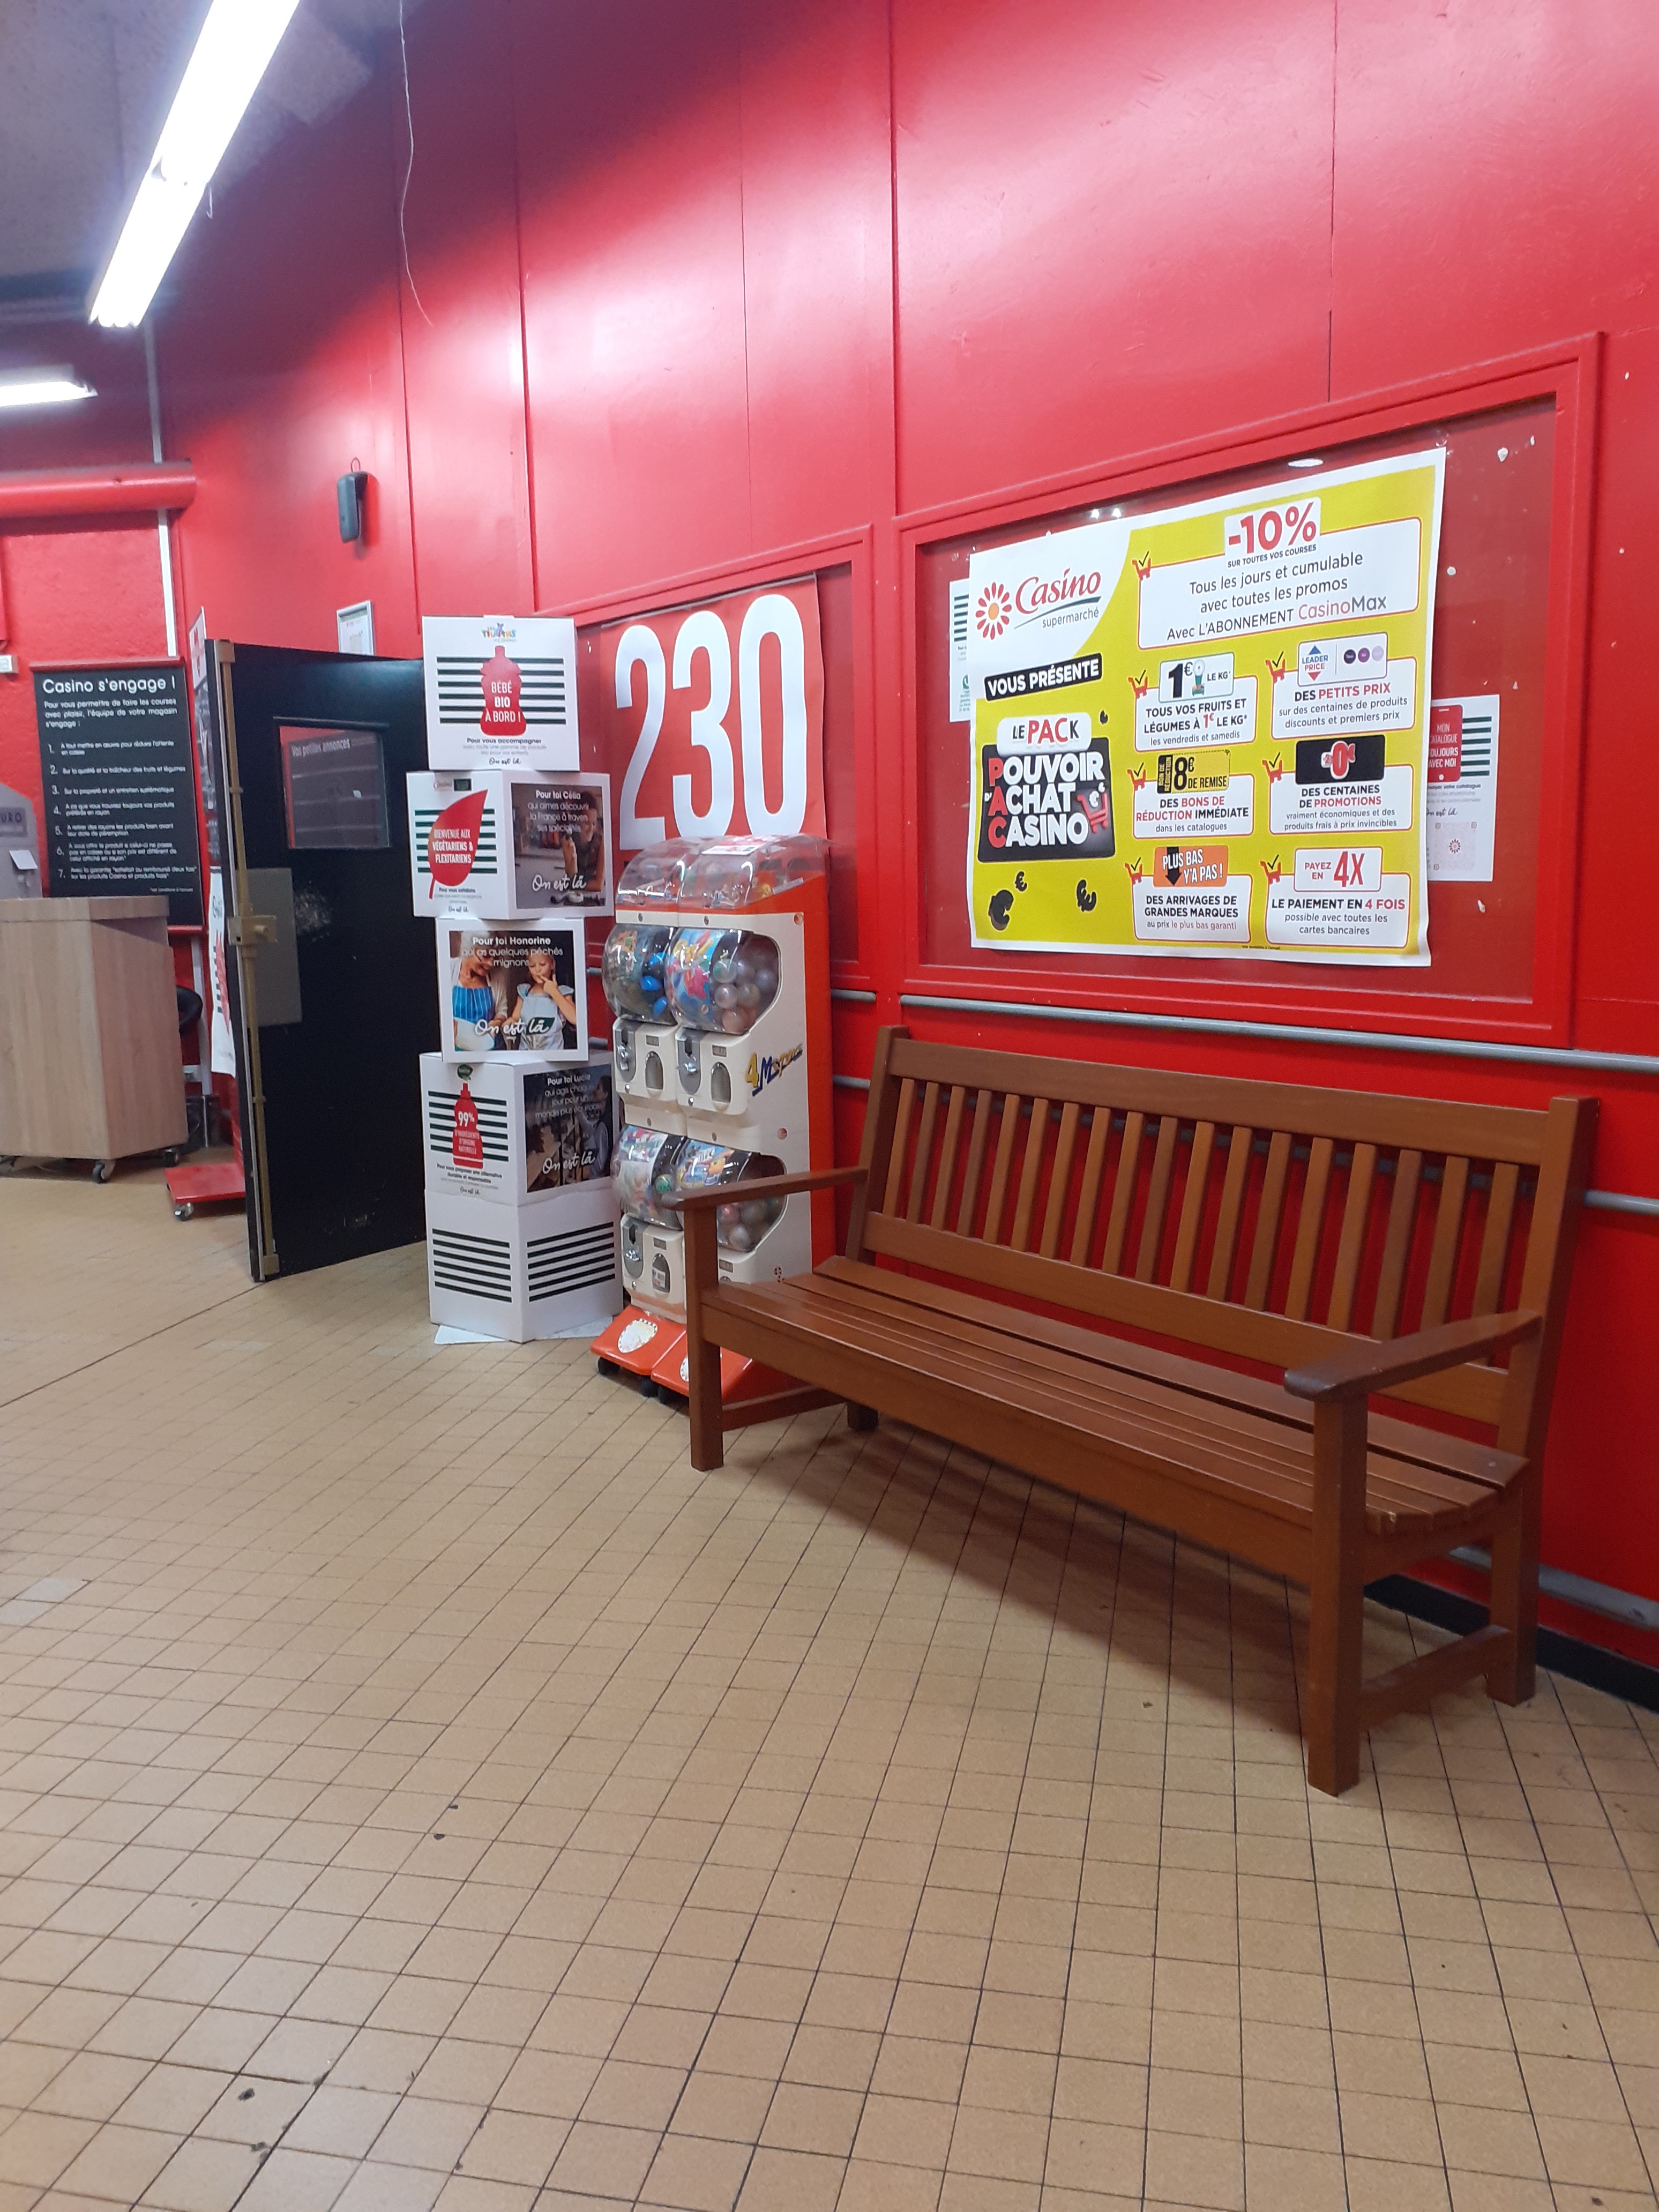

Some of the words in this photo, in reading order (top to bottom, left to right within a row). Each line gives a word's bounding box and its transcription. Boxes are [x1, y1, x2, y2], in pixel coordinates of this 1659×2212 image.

[1228, 502, 1317, 554] -10%
[1228, 561, 1240, 569] SUR
[1242, 554, 1268, 565] TOUTES
[1270, 551, 1283, 560] VOS
[1284, 544, 1317, 558] COURSES
[1189, 579, 1217, 595] Tous
[1220, 576, 1237, 590] les
[1240, 571, 1272, 589] jours
[1275, 566, 1288, 579] et
[1291, 552, 1363, 577] cumulable
[1015, 567, 1101, 614] Casino
[1200, 599, 1228, 614] avec
[1231, 591, 1271, 608] toutes
[1274, 586, 1292, 601] les
[1295, 577, 1348, 600] promos
[1042, 607, 1099, 629] supermarché
[1167, 626, 1195, 641] Avec
[1199, 608, 1294, 636] L'ABONNEMENT
[1298, 595, 1387, 621] CasinoMax
[1302, 655, 1328, 664] LEADER
[1304, 663, 1325, 671] PRICE
[988, 674, 1027, 697] VOUS
[1029, 659, 1099, 690] PRÉSENTE
[1207, 672, 1216, 681] LE
[43, 678, 94, 694] Casino
[99, 678, 166, 694] s'engage
[491, 680, 512, 693] BÉBÉ
[1295, 690, 1316, 702] DES
[1319, 685, 1359, 699] PETITS
[1363, 682, 1391, 695] PRIX
[494, 696, 510, 707] BIO
[1146, 706, 1172, 718] TOUS
[1175, 704, 1195, 715] VOS
[1198, 700, 1232, 713] FRUITS
[1235, 698, 1247, 709] ET
[1279, 708, 1291, 716] sur
[1294, 705, 1307, 715] des
[1310, 702, 1352, 713] centaines
[1356, 700, 1367, 709] de
[1370, 696, 1407, 711] produits
[485, 708, 491, 722] À
[493, 711, 515, 722] BORD
[1285, 716, 1325, 728] discounts
[1328, 715, 1337, 724] et
[1340, 712, 1380, 725] premiers
[1382, 710, 1400, 722] prix
[615, 594, 807, 850] 230
[1144, 720, 1190, 734] LÉGUMES
[1193, 718, 1200, 730] À
[1217, 717, 1228, 727] LE
[1437, 723, 1450, 733] MON
[1012, 724, 1025, 739] LE
[1027, 718, 1080, 744] PACK
[1150, 736, 1161, 746] les
[1163, 734, 1199, 744] vendredis
[1210, 730, 1240, 741] samedis
[1430, 733, 1458, 744] ATALOGUE
[988, 751, 1105, 786] POUVOIR
[1429, 759, 1444, 768] AVEC
[1444, 758, 1456, 767] MOI
[1188, 778, 1198, 789] DE
[1199, 775, 1227, 788] REMISE
[536, 790, 551, 799] Pour
[552, 790, 562, 799] toi
[563, 790, 581, 799] Célia
[1302, 787, 1320, 797] DES
[1323, 784, 1380, 796] CENTAINES
[1160, 798, 1178, 808] DES
[1181, 797, 1209, 807] BONS
[1212, 796, 1225, 805] DE
[1299, 799, 1312, 808] DE
[1314, 796, 1381, 808] PROMOTIONS
[1136, 810, 1192, 821] RÉDUCTION
[1195, 806, 1249, 819] IMMÉDIATE
[1286, 811, 1317, 820] vraiment
[1319, 809, 1370, 820] économiques
[1382, 808, 1395, 816] des
[988, 812, 1088, 848] CASINO
[1156, 824, 1172, 833] dans
[1175, 823, 1185, 832] les
[1187, 823, 1227, 832] catalogues
[1284, 822, 1313, 831] produits
[1316, 820, 1332, 829] frais
[1340, 820, 1355, 830] prix
[1357, 819, 1397, 828] invincibles
[461, 829, 471, 839] AUX
[432, 840, 467, 851] VÉGÉTARIENS
[435, 854, 472, 864] FLEXITARIENS
[1162, 853, 1184, 871] PLUS
[1186, 848, 1203, 865] BAS
[1304, 862, 1331, 870] PAYEZ
[1334, 851, 1365, 887] 4X
[1183, 868, 1198, 885] Y'A
[1200, 865, 1217, 881] PAS
[1312, 872, 1323, 880] EN
[532, 875, 551, 891] On
[553, 875, 570, 891] est
[572, 875, 587, 890] là
[1146, 895, 1163, 905] DES
[1166, 895, 1220, 905] ARRIVAGES
[1223, 896, 1237, 905] DE
[1272, 899, 1285, 908] LE
[1288, 899, 1344, 909] PAIEMENT
[1347, 899, 1362, 909] EN
[1365, 899, 1372, 909] 4
[1376, 899, 1406, 909] FOIS
[1145, 907, 1188, 917] GRANDES
[1190, 908, 1238, 918] MARQUES
[1285, 913, 1319, 922] possible
[1344, 914, 1372, 922] toutes
[1374, 914, 1388, 922] les
[1157, 920, 1169, 929] prix
[1179, 921, 1194, 930] plus
[1210, 921, 1237, 931] garanti
[1299, 925, 1325, 934] cartes
[1327, 925, 1370, 935] bancaires
[473, 937, 492, 945] Pour
[496, 937, 507, 946] toi
[510, 936, 551, 945] Honorine
[462, 947, 475, 958] qui
[489, 947, 529, 958] quelques
[531, 946, 563, 957] péchés
[494, 959, 530, 968] mignons
[475, 1019, 499, 1035] On
[503, 1019, 523, 1036] est
[529, 1019, 550, 1033] là
[547, 1077, 563, 1086] Pour
[564, 1075, 573, 1083] toi
[458, 1111, 475, 1127] 99%
[542, 1158, 561, 1174] On
[563, 1153, 579, 1171] est
[581, 1151, 595, 1164] là
